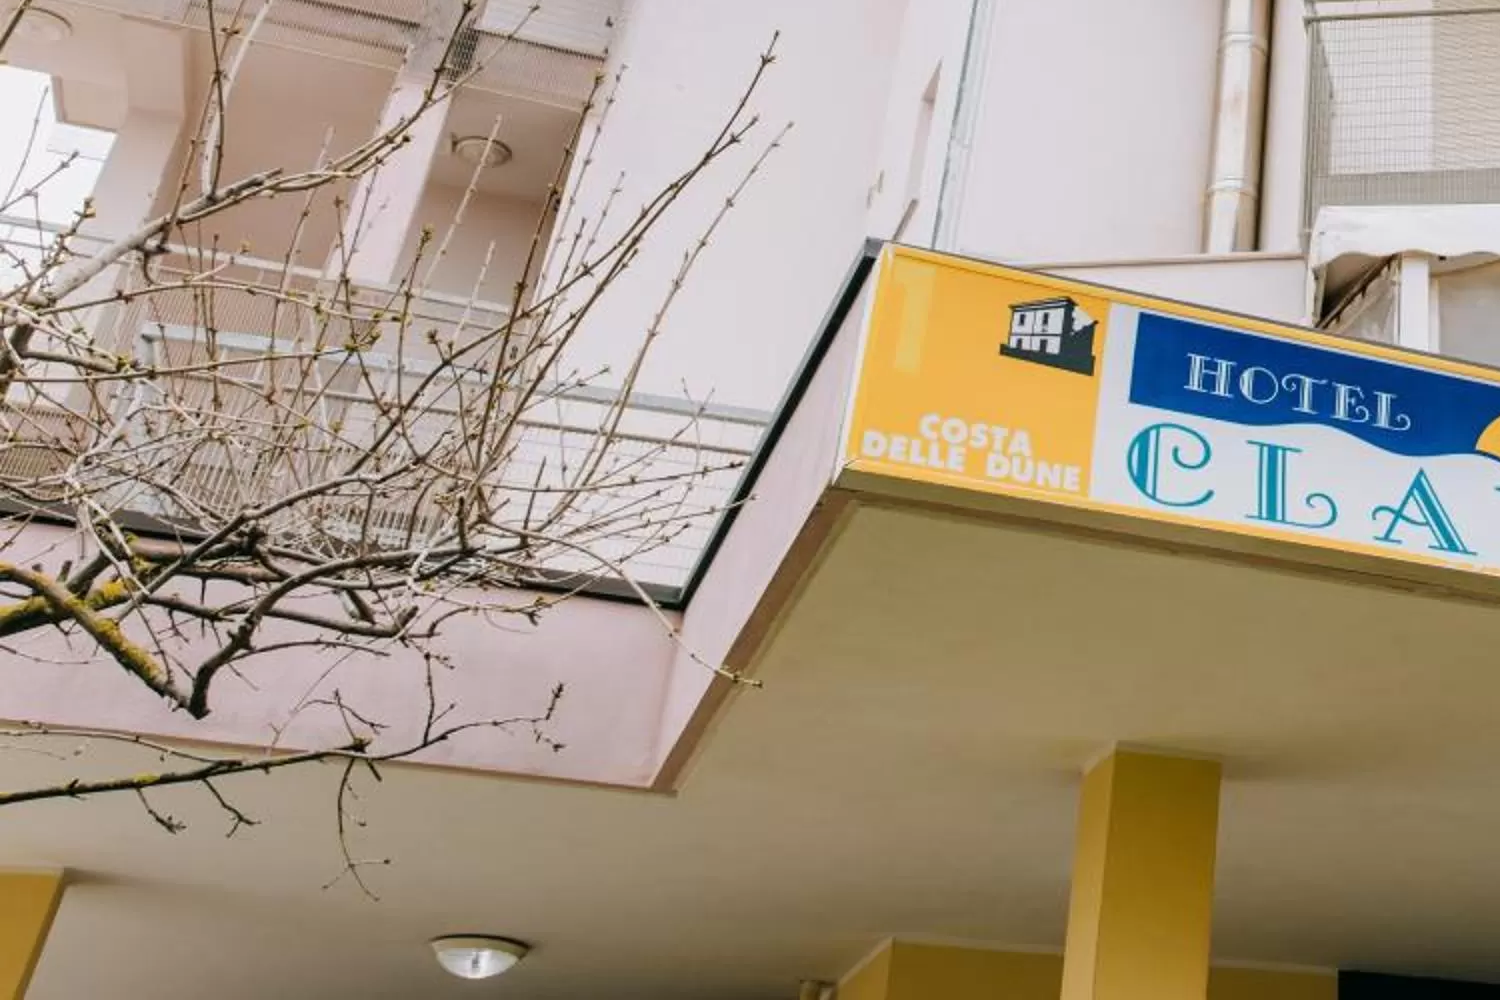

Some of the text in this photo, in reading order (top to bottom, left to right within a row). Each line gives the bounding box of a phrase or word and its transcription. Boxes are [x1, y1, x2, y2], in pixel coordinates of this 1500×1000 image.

[1183, 352, 1411, 432] HOTEL
[861, 430, 1081, 491] DELLE DUNE
[919, 412, 1033, 456] COSTA
